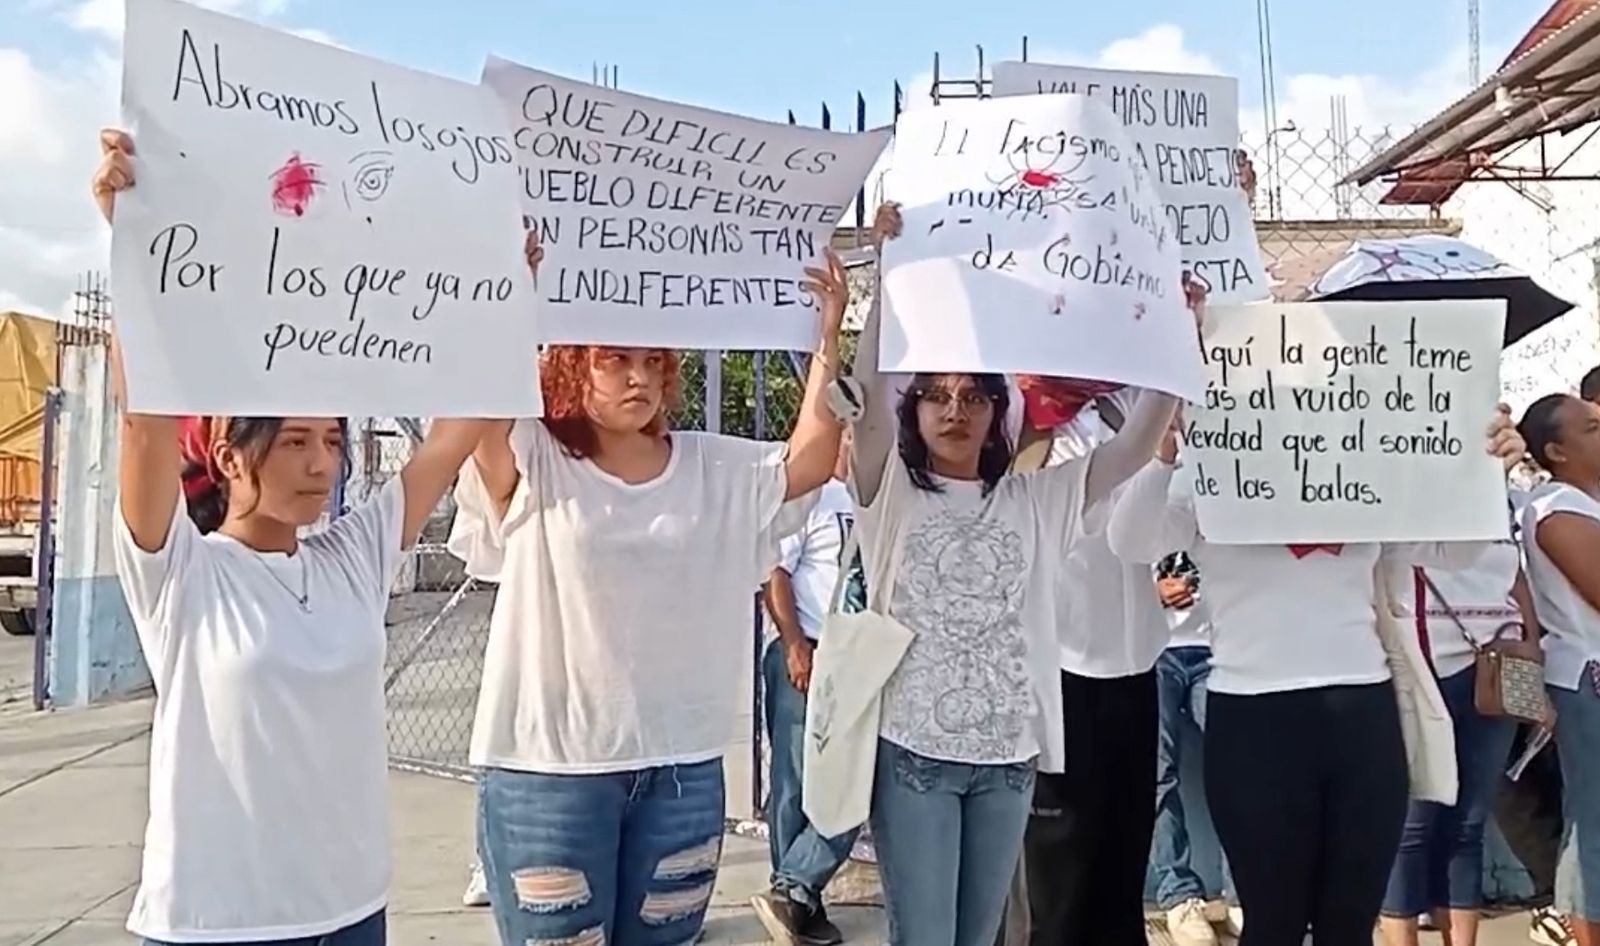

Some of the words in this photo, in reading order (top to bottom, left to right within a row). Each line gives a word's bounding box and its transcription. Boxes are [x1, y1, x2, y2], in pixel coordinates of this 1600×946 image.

[173, 29, 358, 134] Abramos
[1113, 84, 1156, 126] MÁS
[1164, 88, 1208, 128] UNA
[522, 84, 616, 133] QUE
[621, 108, 767, 166] DIFICIL
[784, 148, 836, 174] ES
[514, 127, 712, 180] CONSTRUIR
[738, 170, 786, 193] UN
[518, 166, 634, 207] UEBLO
[648, 181, 842, 224] DIFERENTE
[578, 216, 744, 256] PERSONAS
[750, 228, 815, 260] TAN
[150, 223, 225, 294] Por
[266, 226, 327, 296] los
[344, 263, 406, 321] que
[413, 272, 461, 320] ya
[472, 275, 513, 302] no
[1181, 258, 1253, 293] STA
[1280, 315, 1304, 365] la
[1323, 324, 1389, 378] gente
[1404, 316, 1473, 371] teme
[1205, 381, 1236, 411] ás
[1249, 370, 1275, 410] al
[1292, 376, 1371, 413] ruido
[1384, 375, 1415, 412] de
[1428, 373, 1450, 412] la
[1282, 432, 1328, 471] que
[1341, 418, 1364, 453] al
[1379, 420, 1462, 456] sonido
[1195, 462, 1219, 496] de
[1236, 458, 1275, 500] las
[1300, 459, 1382, 504] balas.
